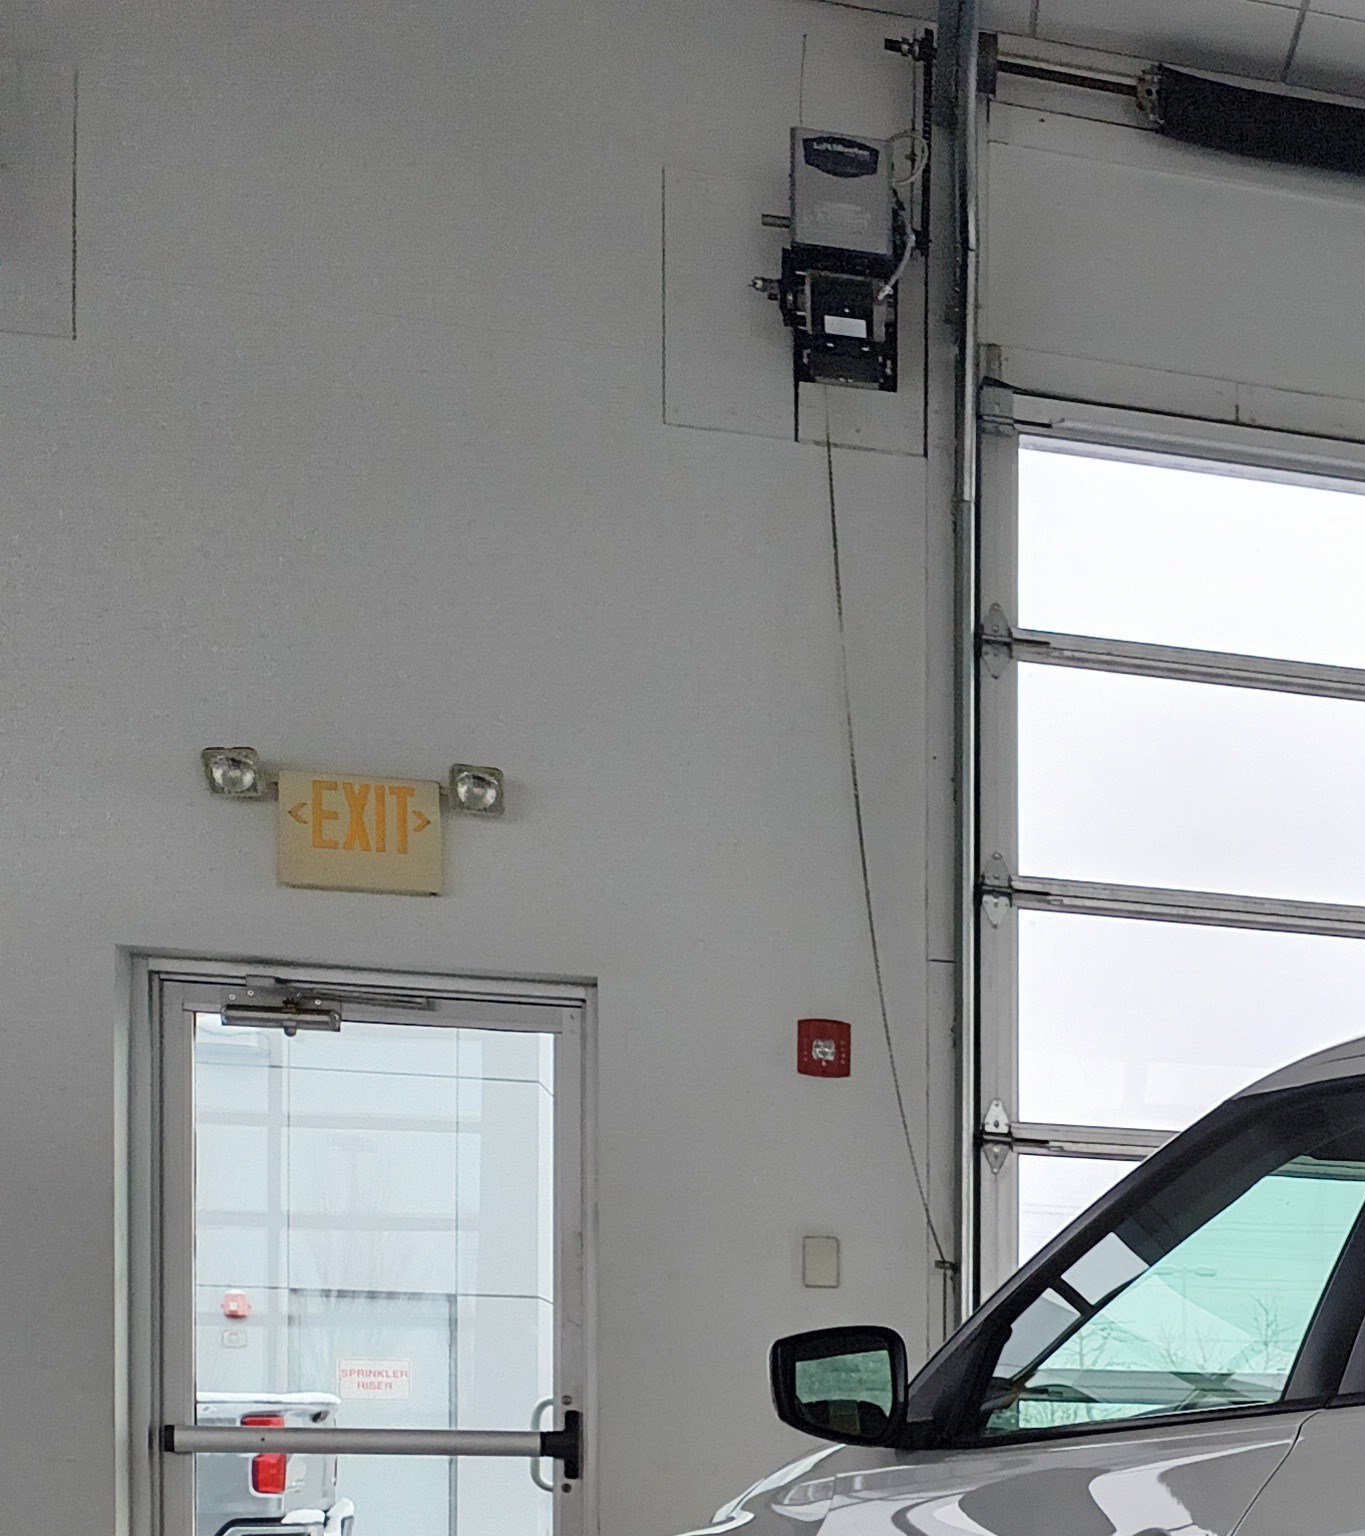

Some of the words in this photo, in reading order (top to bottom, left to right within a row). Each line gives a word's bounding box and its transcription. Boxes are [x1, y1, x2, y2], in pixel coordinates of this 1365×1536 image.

[312, 779, 416, 855] EXIT
[341, 1368, 408, 1379] SPRINKLER
[357, 1381, 393, 1390] RISER
